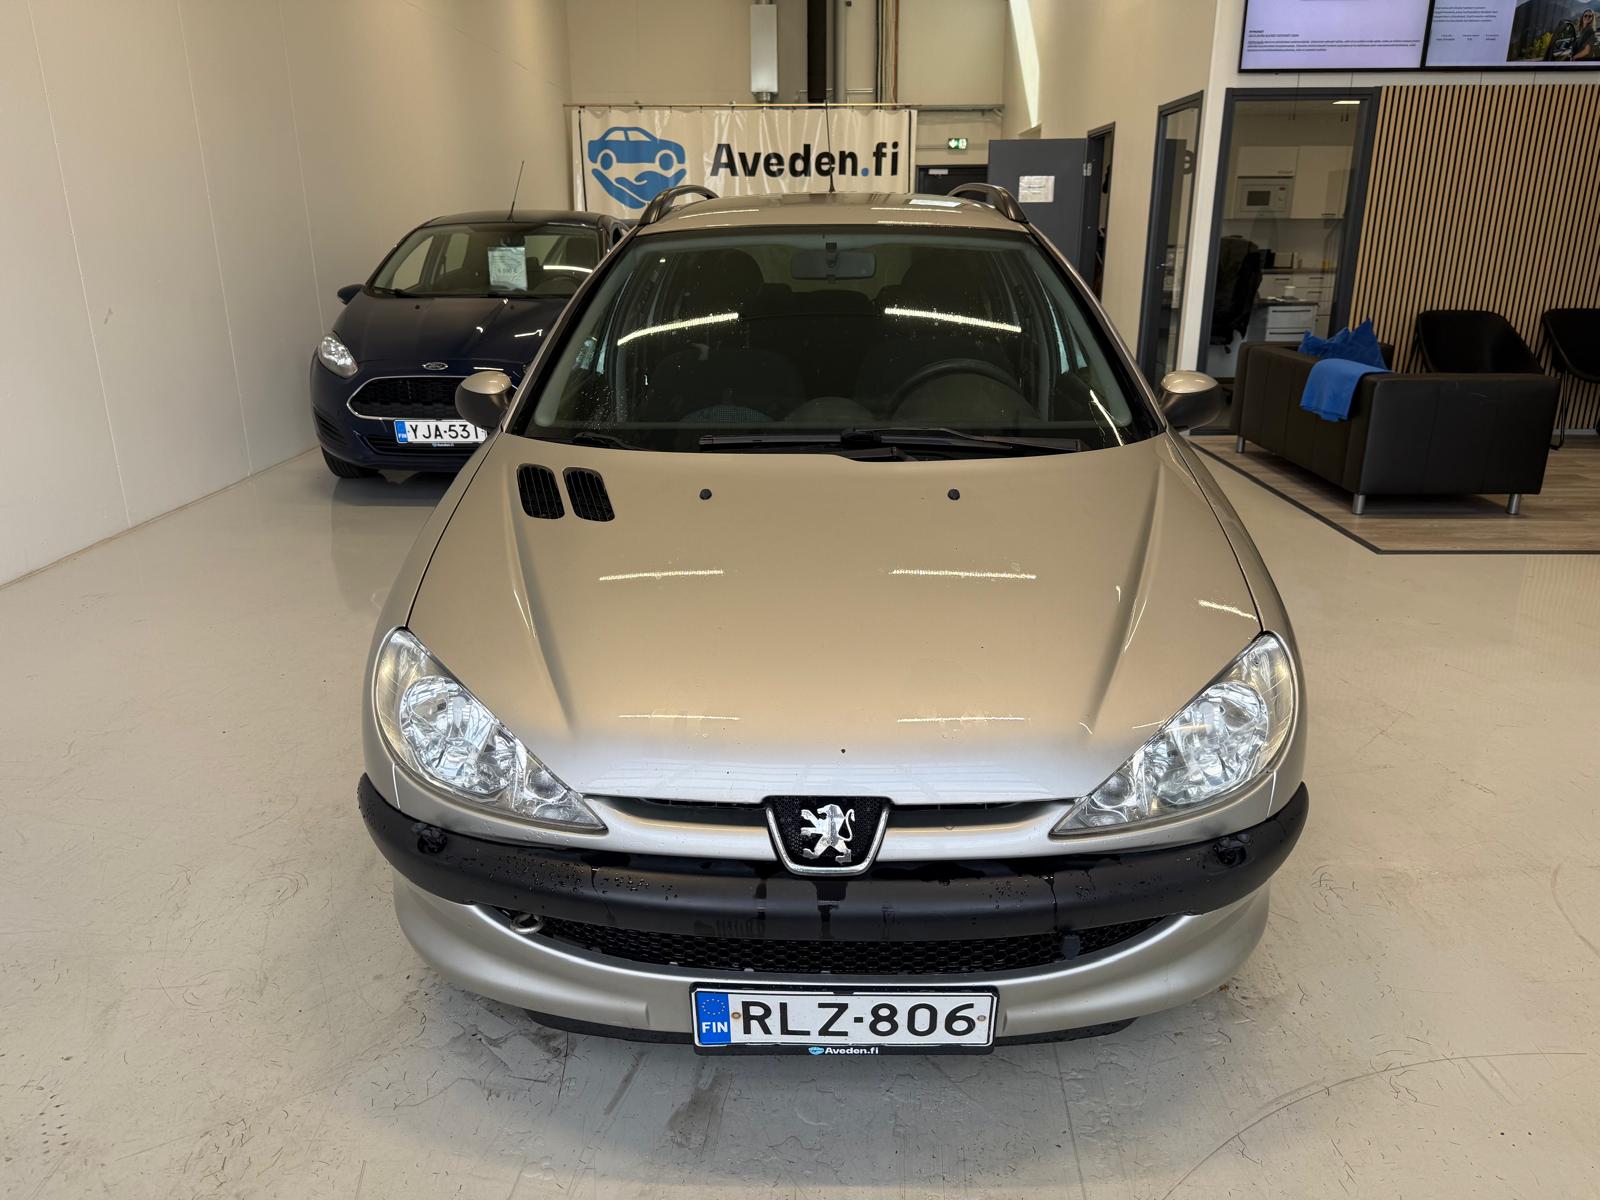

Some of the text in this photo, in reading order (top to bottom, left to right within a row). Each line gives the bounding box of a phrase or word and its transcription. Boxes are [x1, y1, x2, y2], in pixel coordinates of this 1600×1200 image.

[710, 141, 899, 177] Aveden.fi
[409, 424, 479, 439] YJA-531
[741, 1000, 976, 1037] RLZ-806
[701, 1022, 729, 1033] FIN
[824, 1046, 879, 1055] Aveden.fi
